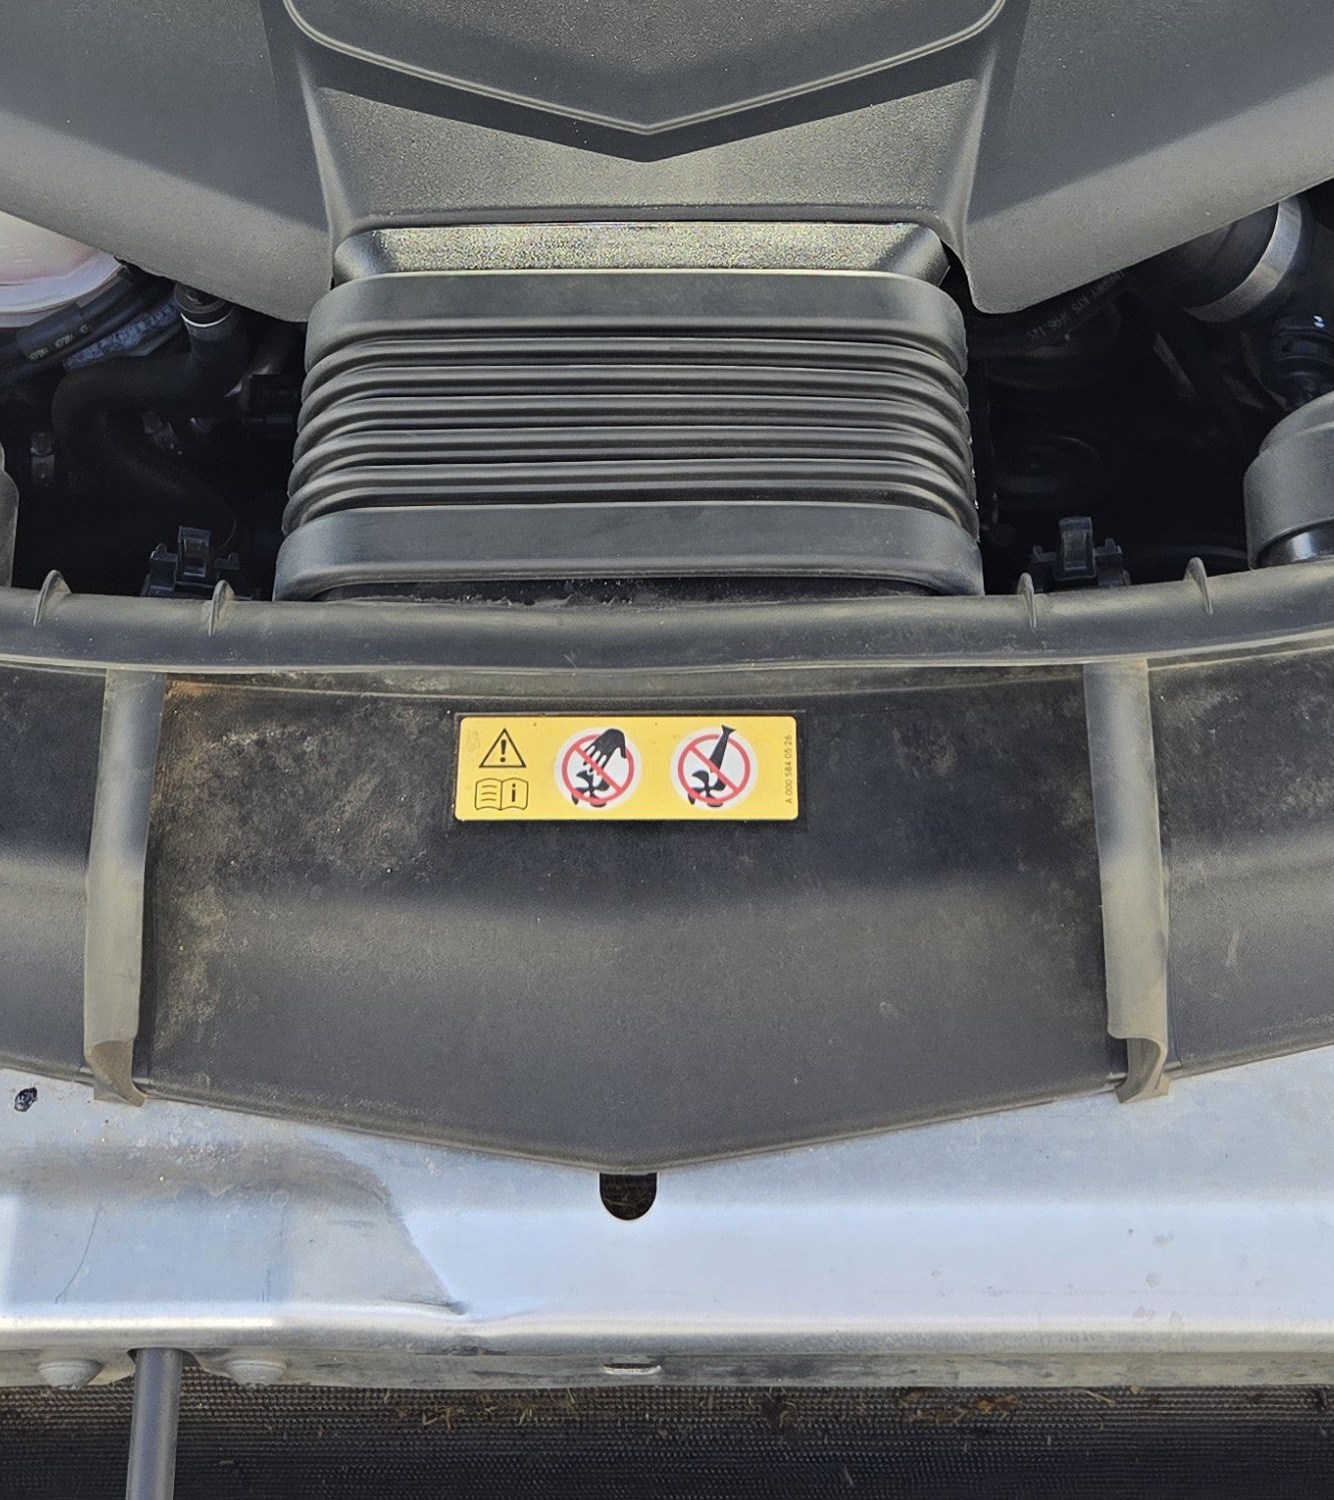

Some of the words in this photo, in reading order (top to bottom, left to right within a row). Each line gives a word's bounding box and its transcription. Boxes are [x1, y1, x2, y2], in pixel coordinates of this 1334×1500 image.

[784, 734, 793, 746] 26
[784, 747, 793, 759] 05
[784, 761, 793, 776] 584
[784, 779, 793, 796] 000
